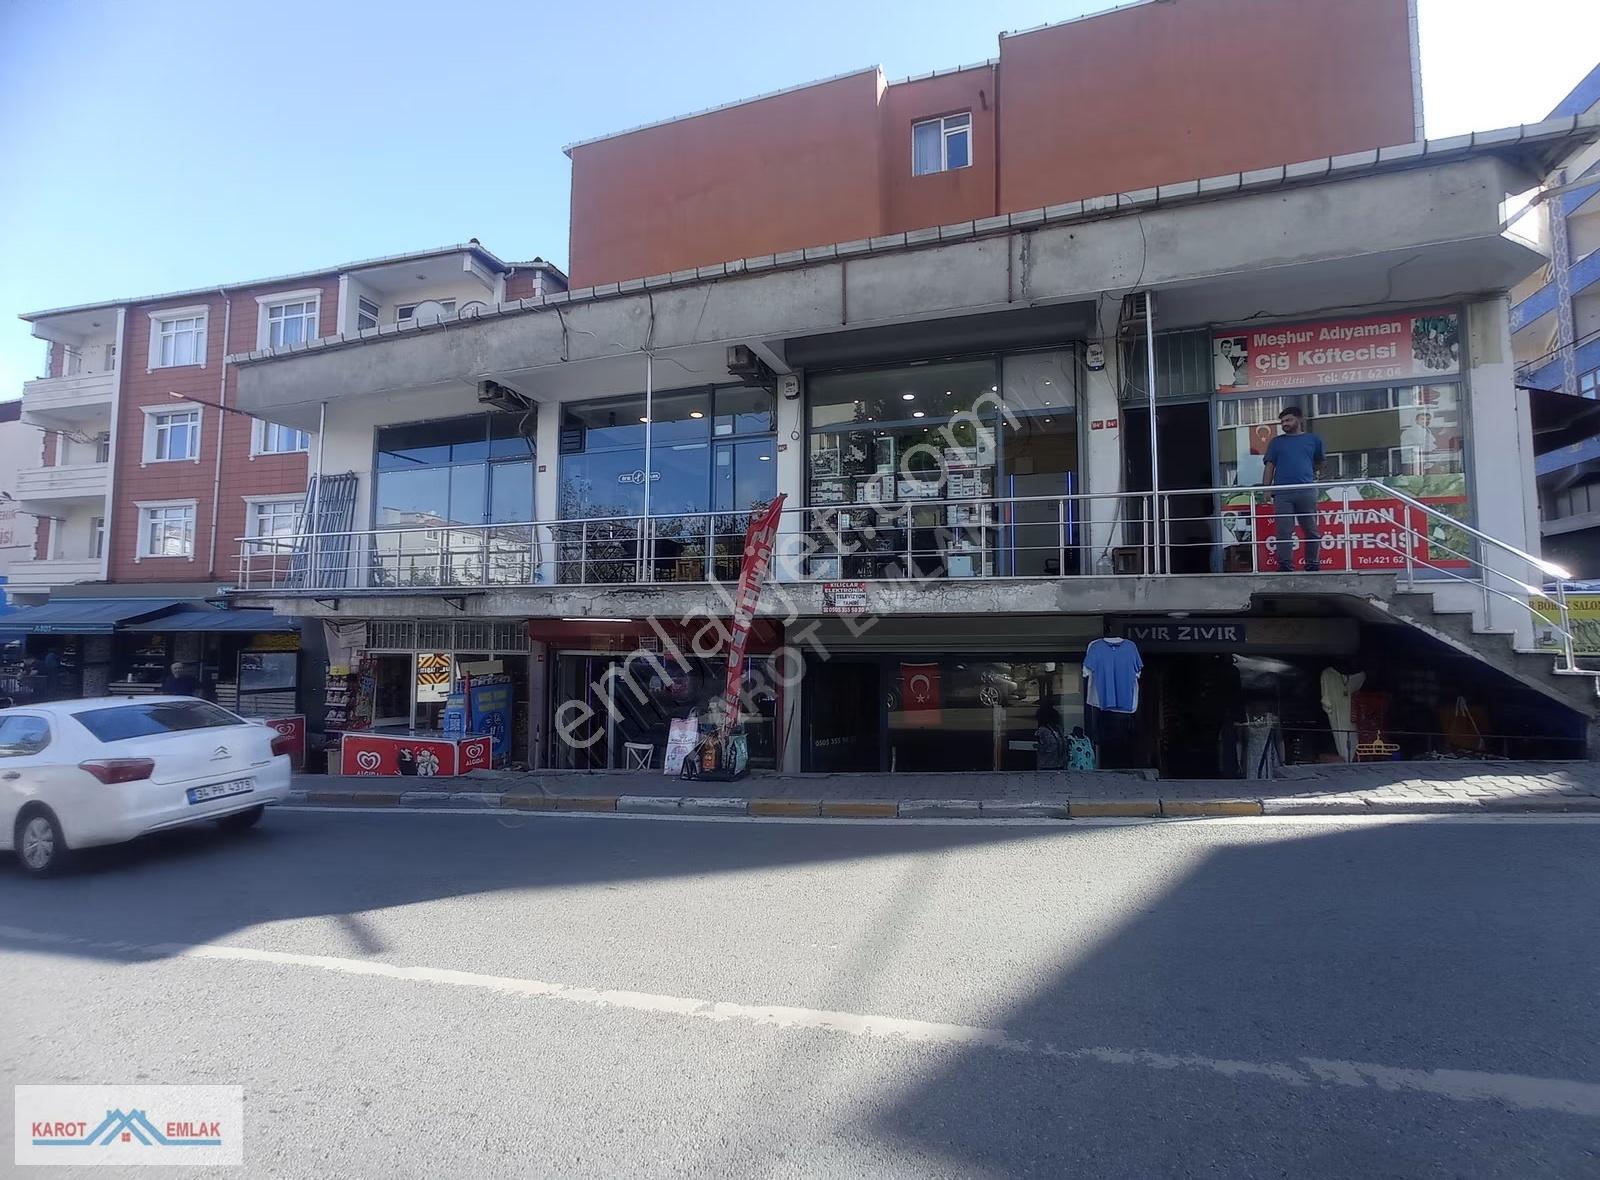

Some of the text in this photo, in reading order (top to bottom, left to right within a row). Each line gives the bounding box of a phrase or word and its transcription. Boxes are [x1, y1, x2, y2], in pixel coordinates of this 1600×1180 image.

[1253, 322, 1401, 348] Meşhur Adıyaman
[1255, 342, 1397, 373] Çiğ Köftecisi
[1393, 555, 1405, 564] 62
[1178, 626, 1237, 641] ZIVIR
[196, 788, 210, 799] 34
